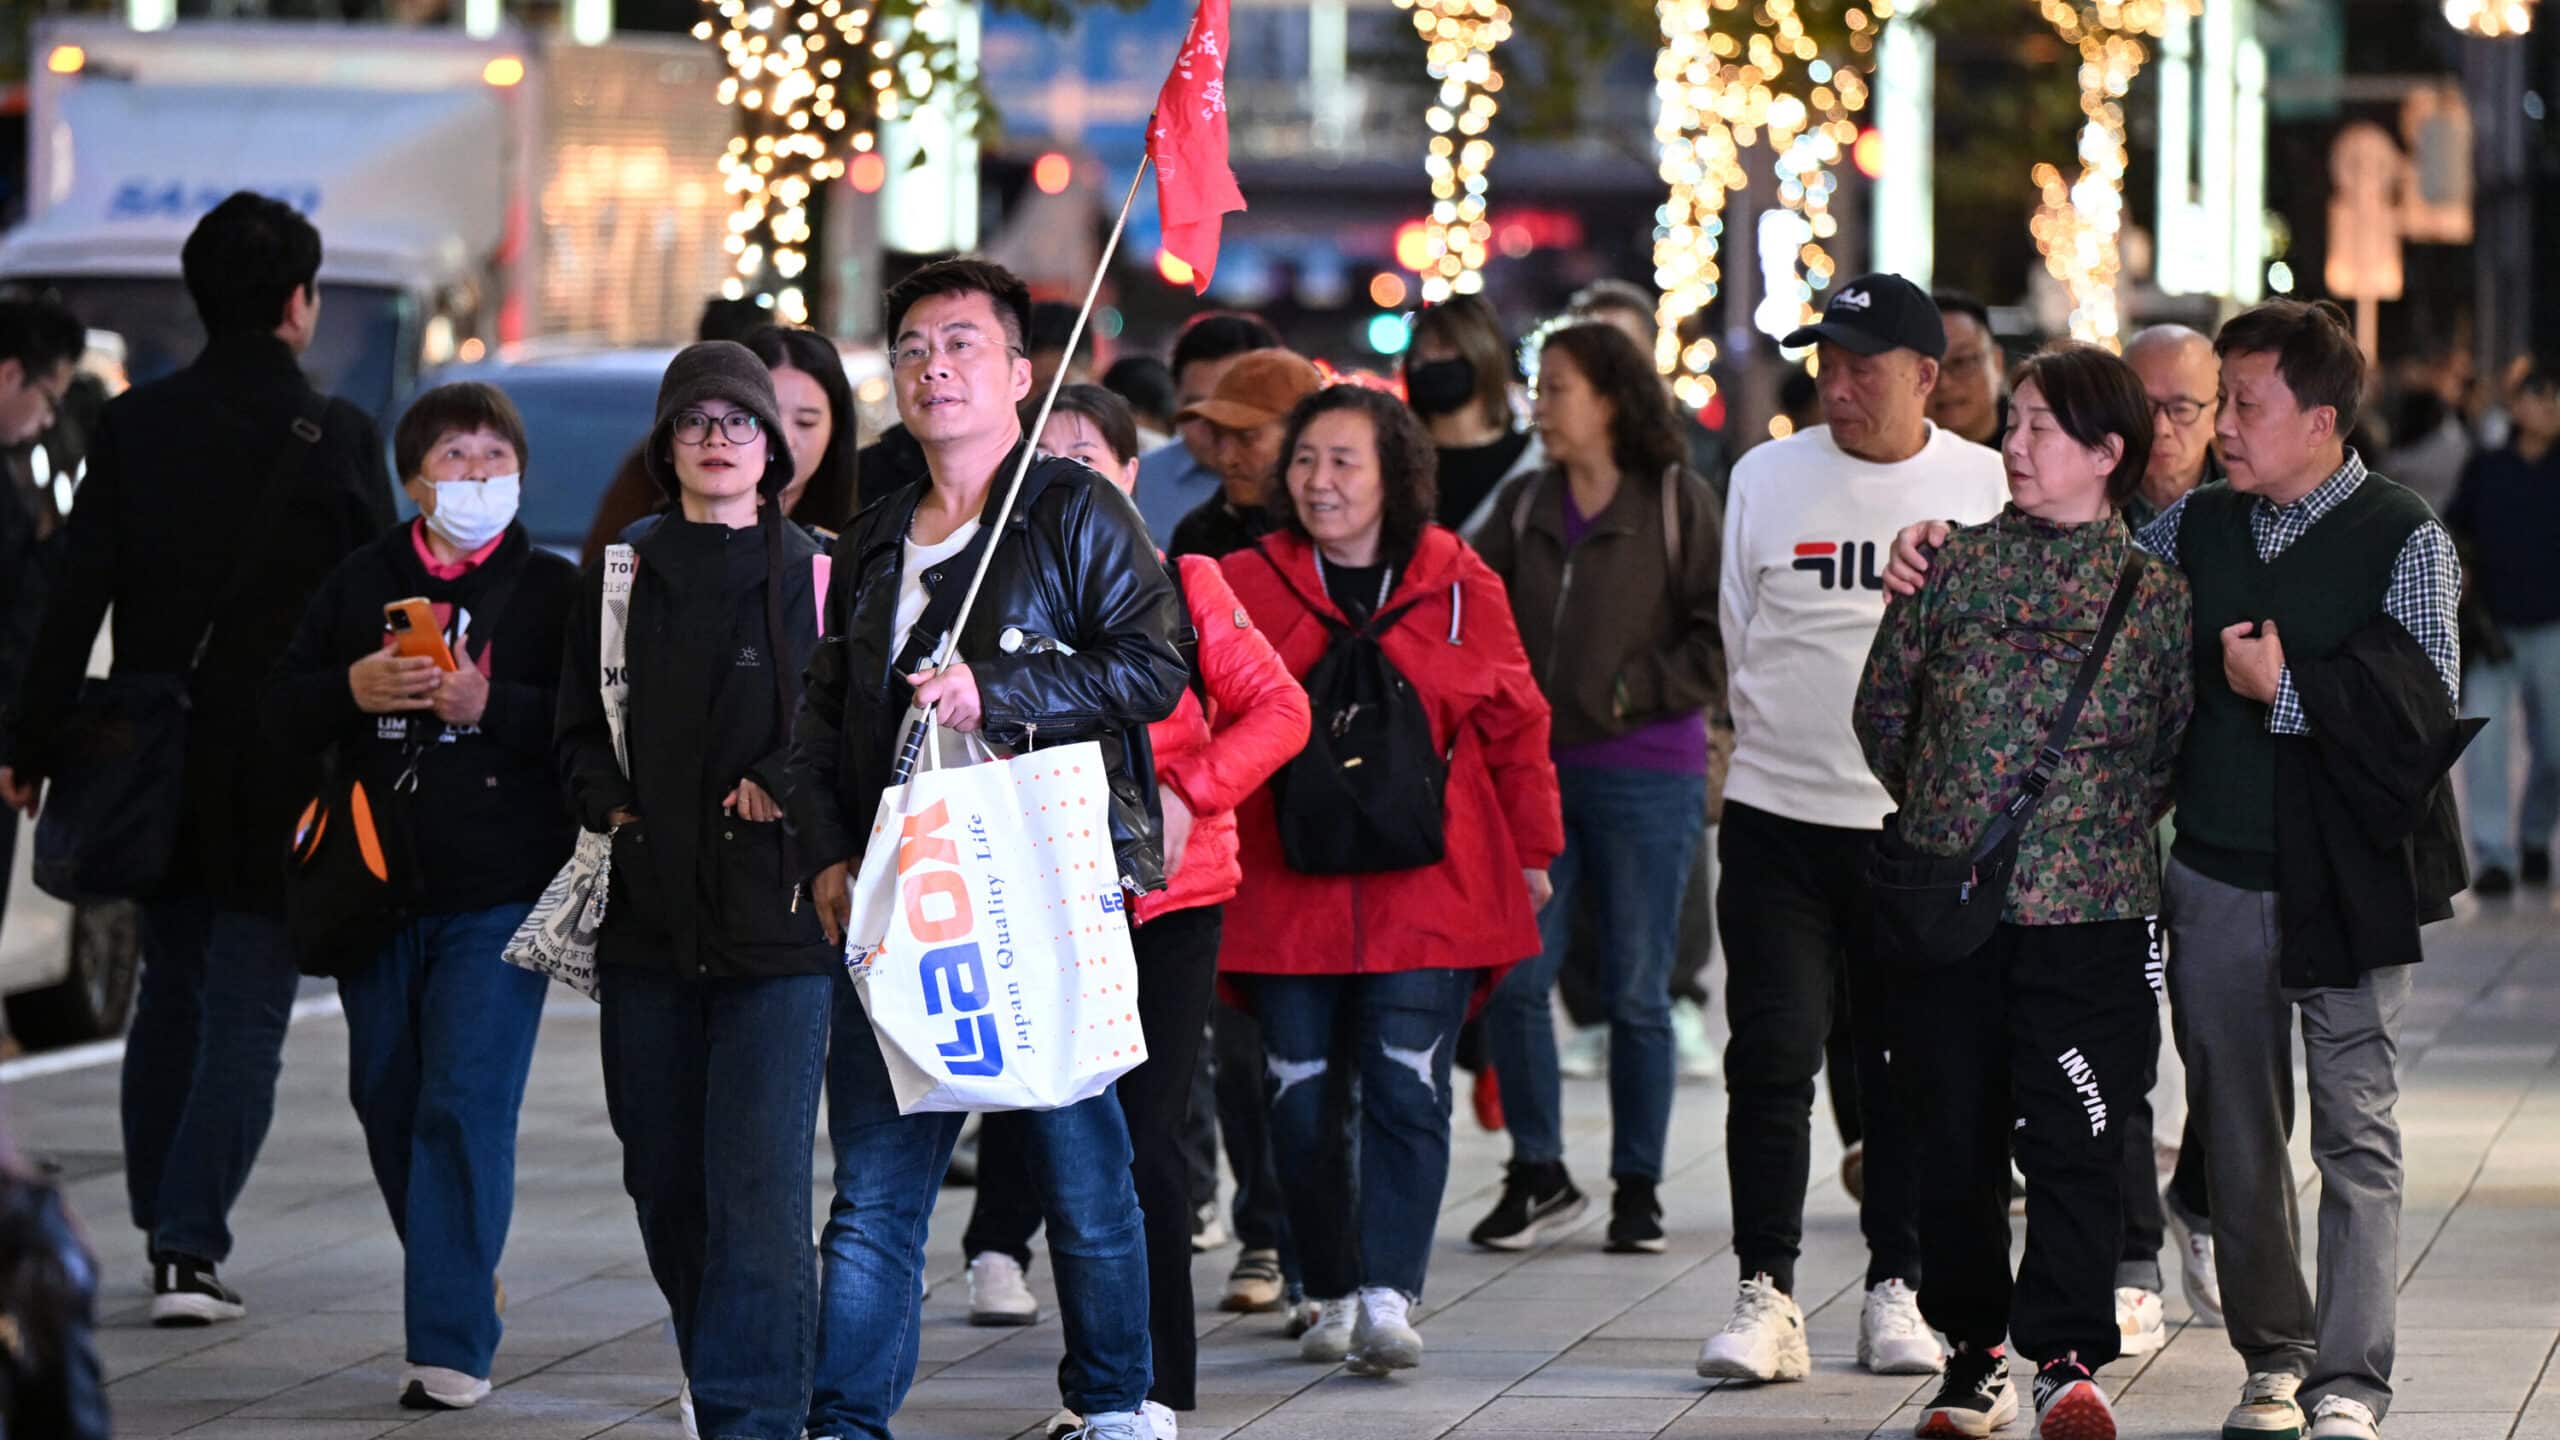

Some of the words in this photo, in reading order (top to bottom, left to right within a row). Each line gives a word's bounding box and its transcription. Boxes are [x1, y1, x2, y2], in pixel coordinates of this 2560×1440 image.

[1792, 540, 1883, 590] FIL
[967, 813, 993, 862] Life
[986, 874, 1015, 970] Quality
[1007, 981, 1036, 1055] Japan
[2057, 1047, 2107, 1137] INSPIRE
